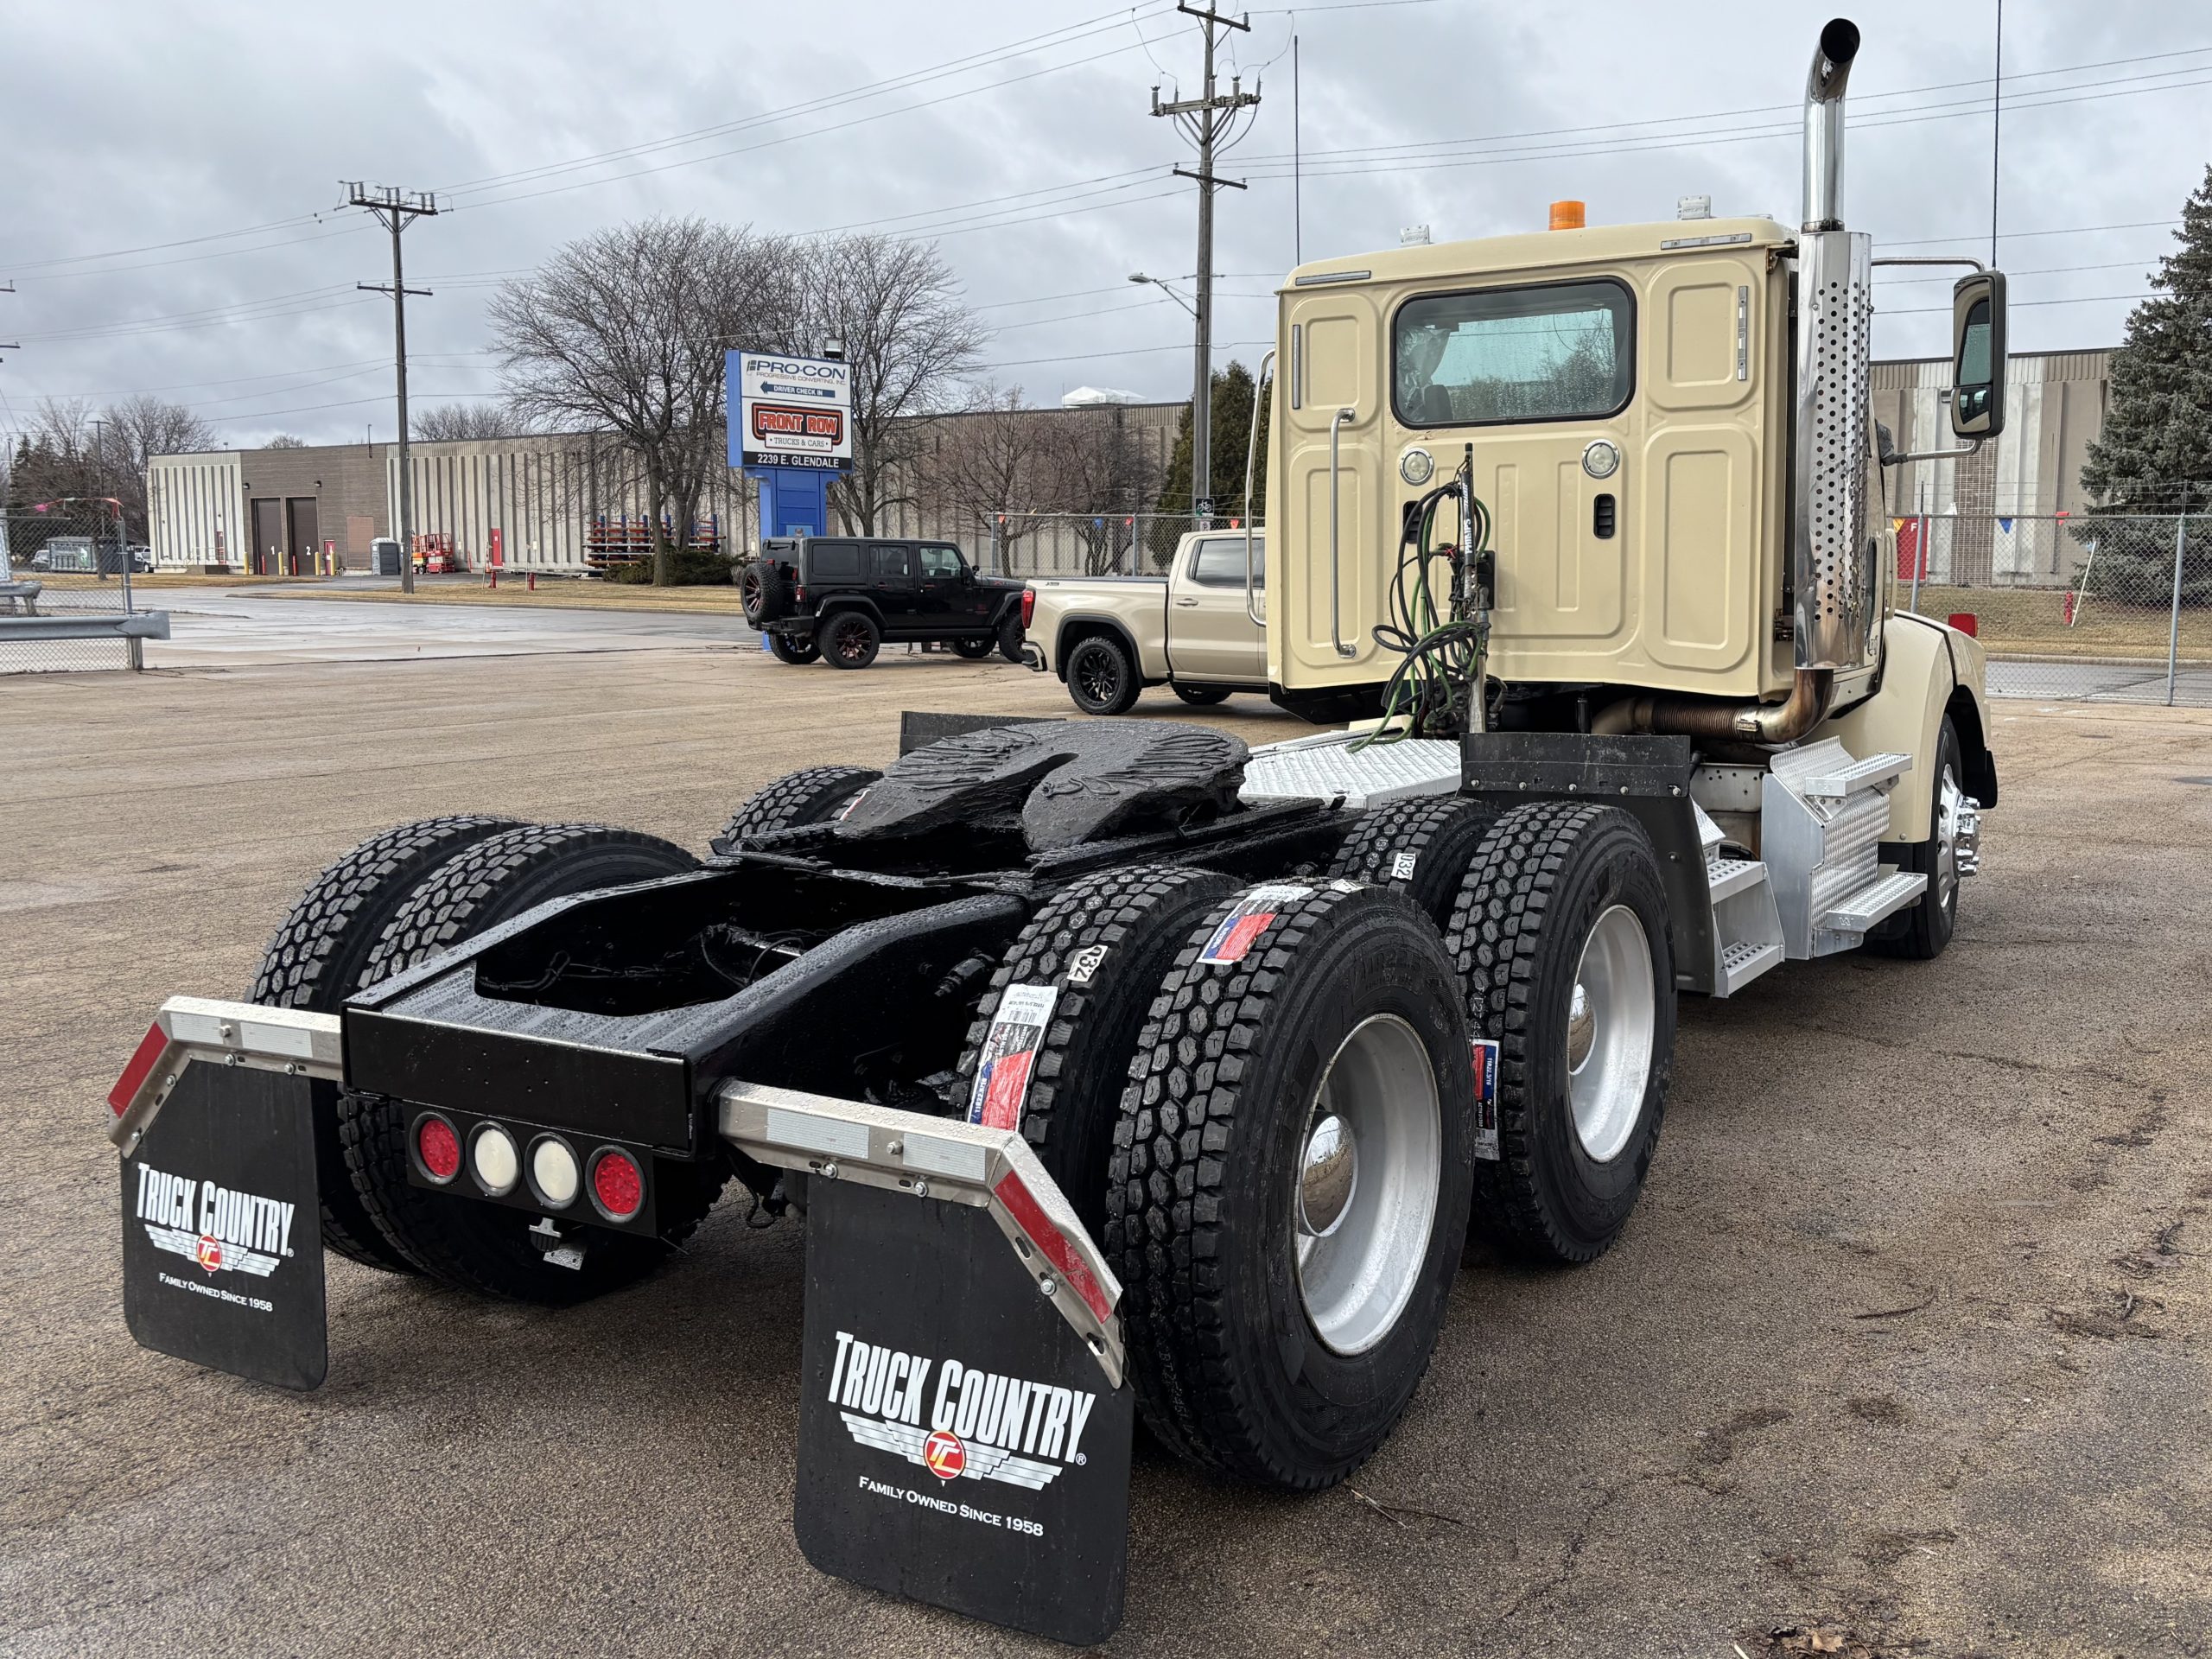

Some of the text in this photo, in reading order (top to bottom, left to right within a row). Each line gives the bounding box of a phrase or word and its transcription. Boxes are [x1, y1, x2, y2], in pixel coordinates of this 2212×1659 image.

[756, 372, 797, 381] PROGRESSIVE
[773, 385, 796, 394] DRIVER
[759, 411, 838, 435] FRONT ROW
[773, 437, 800, 446] TRUCKS
[808, 439, 825, 448] CARS
[757, 454, 840, 468] 2239 E. GLENDALE
[270, 545, 275, 555] 1
[306, 546, 311, 556] 2
[1395, 855, 1415, 876] 032
[137, 1162, 296, 1257] TRUCK COUNTRY
[159, 1272, 273, 1313] FAMILY OWNED SINCE 1958
[828, 1331, 932, 1426] TRUCK
[931, 1359, 1096, 1464] COUNTRY
[859, 1476, 1044, 1537] FAMILY OWNED SINCE 1958
